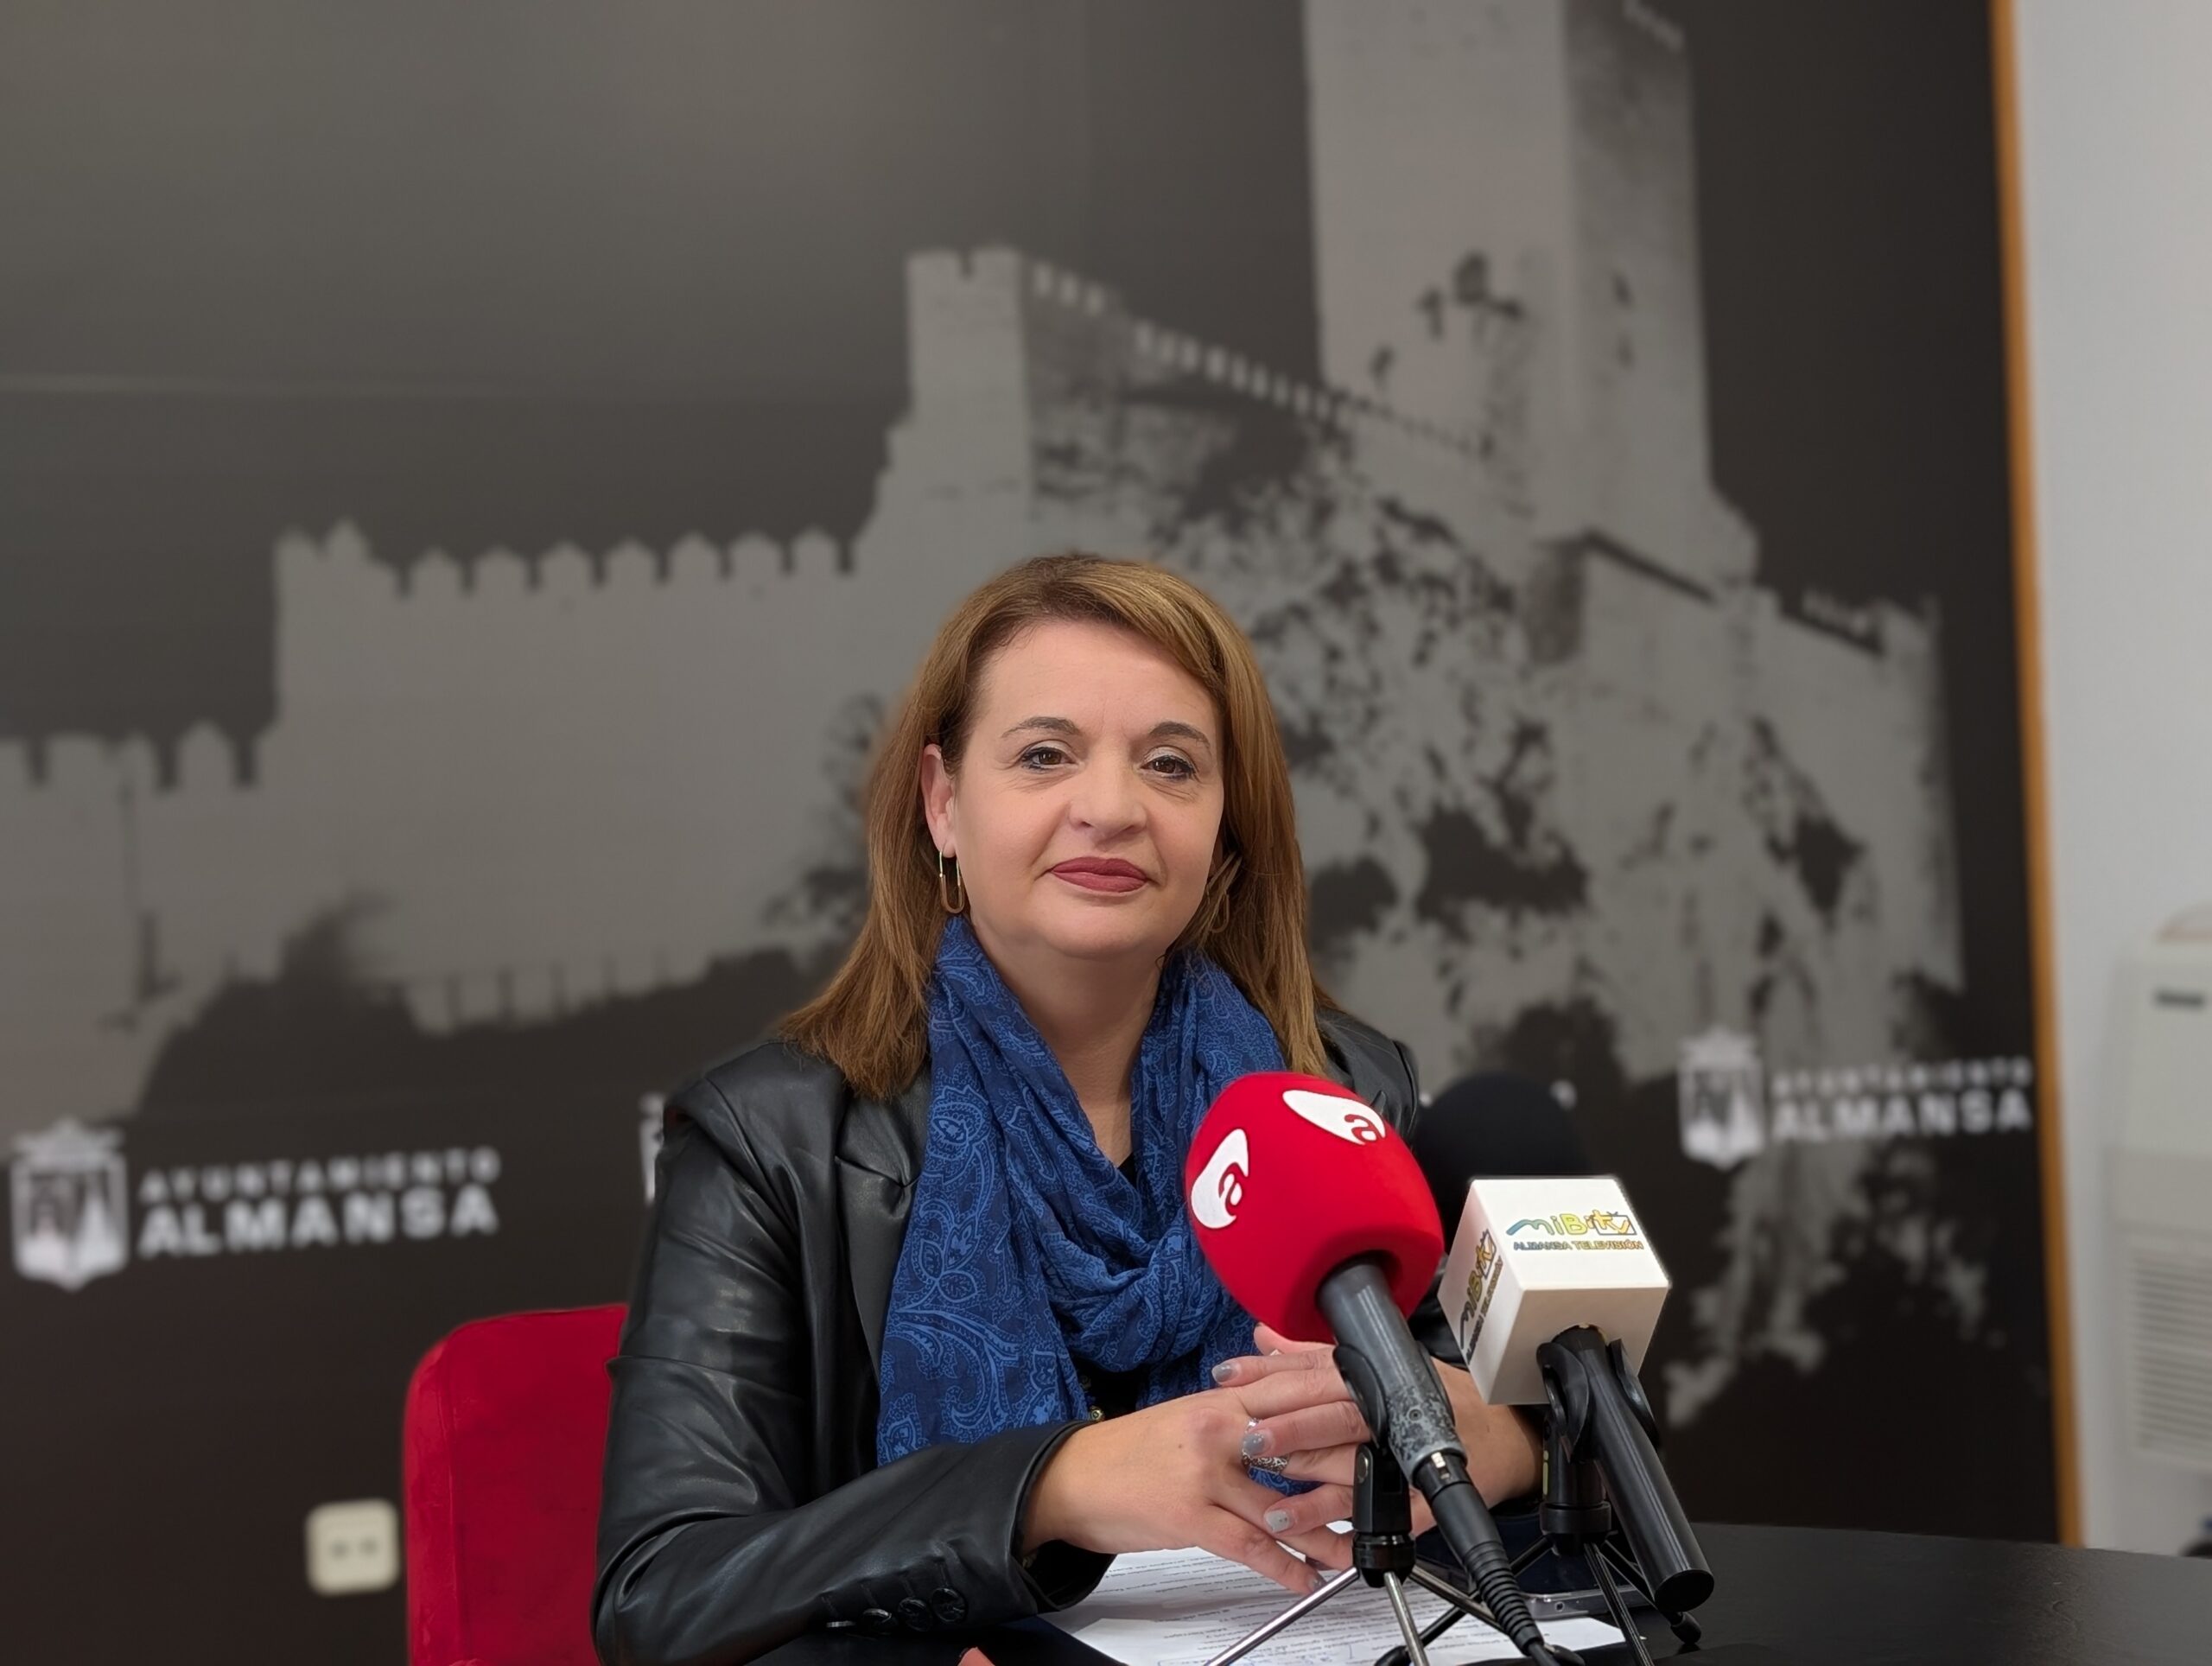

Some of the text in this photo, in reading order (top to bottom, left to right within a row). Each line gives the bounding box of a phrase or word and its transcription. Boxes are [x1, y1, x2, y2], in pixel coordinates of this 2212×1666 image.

[1771, 1088, 2031, 1141] ALMANSA
[137, 1185, 499, 1258] ALMANSA
[1513, 1238, 1644, 1251] ALMANSA TELEVISIÓN
